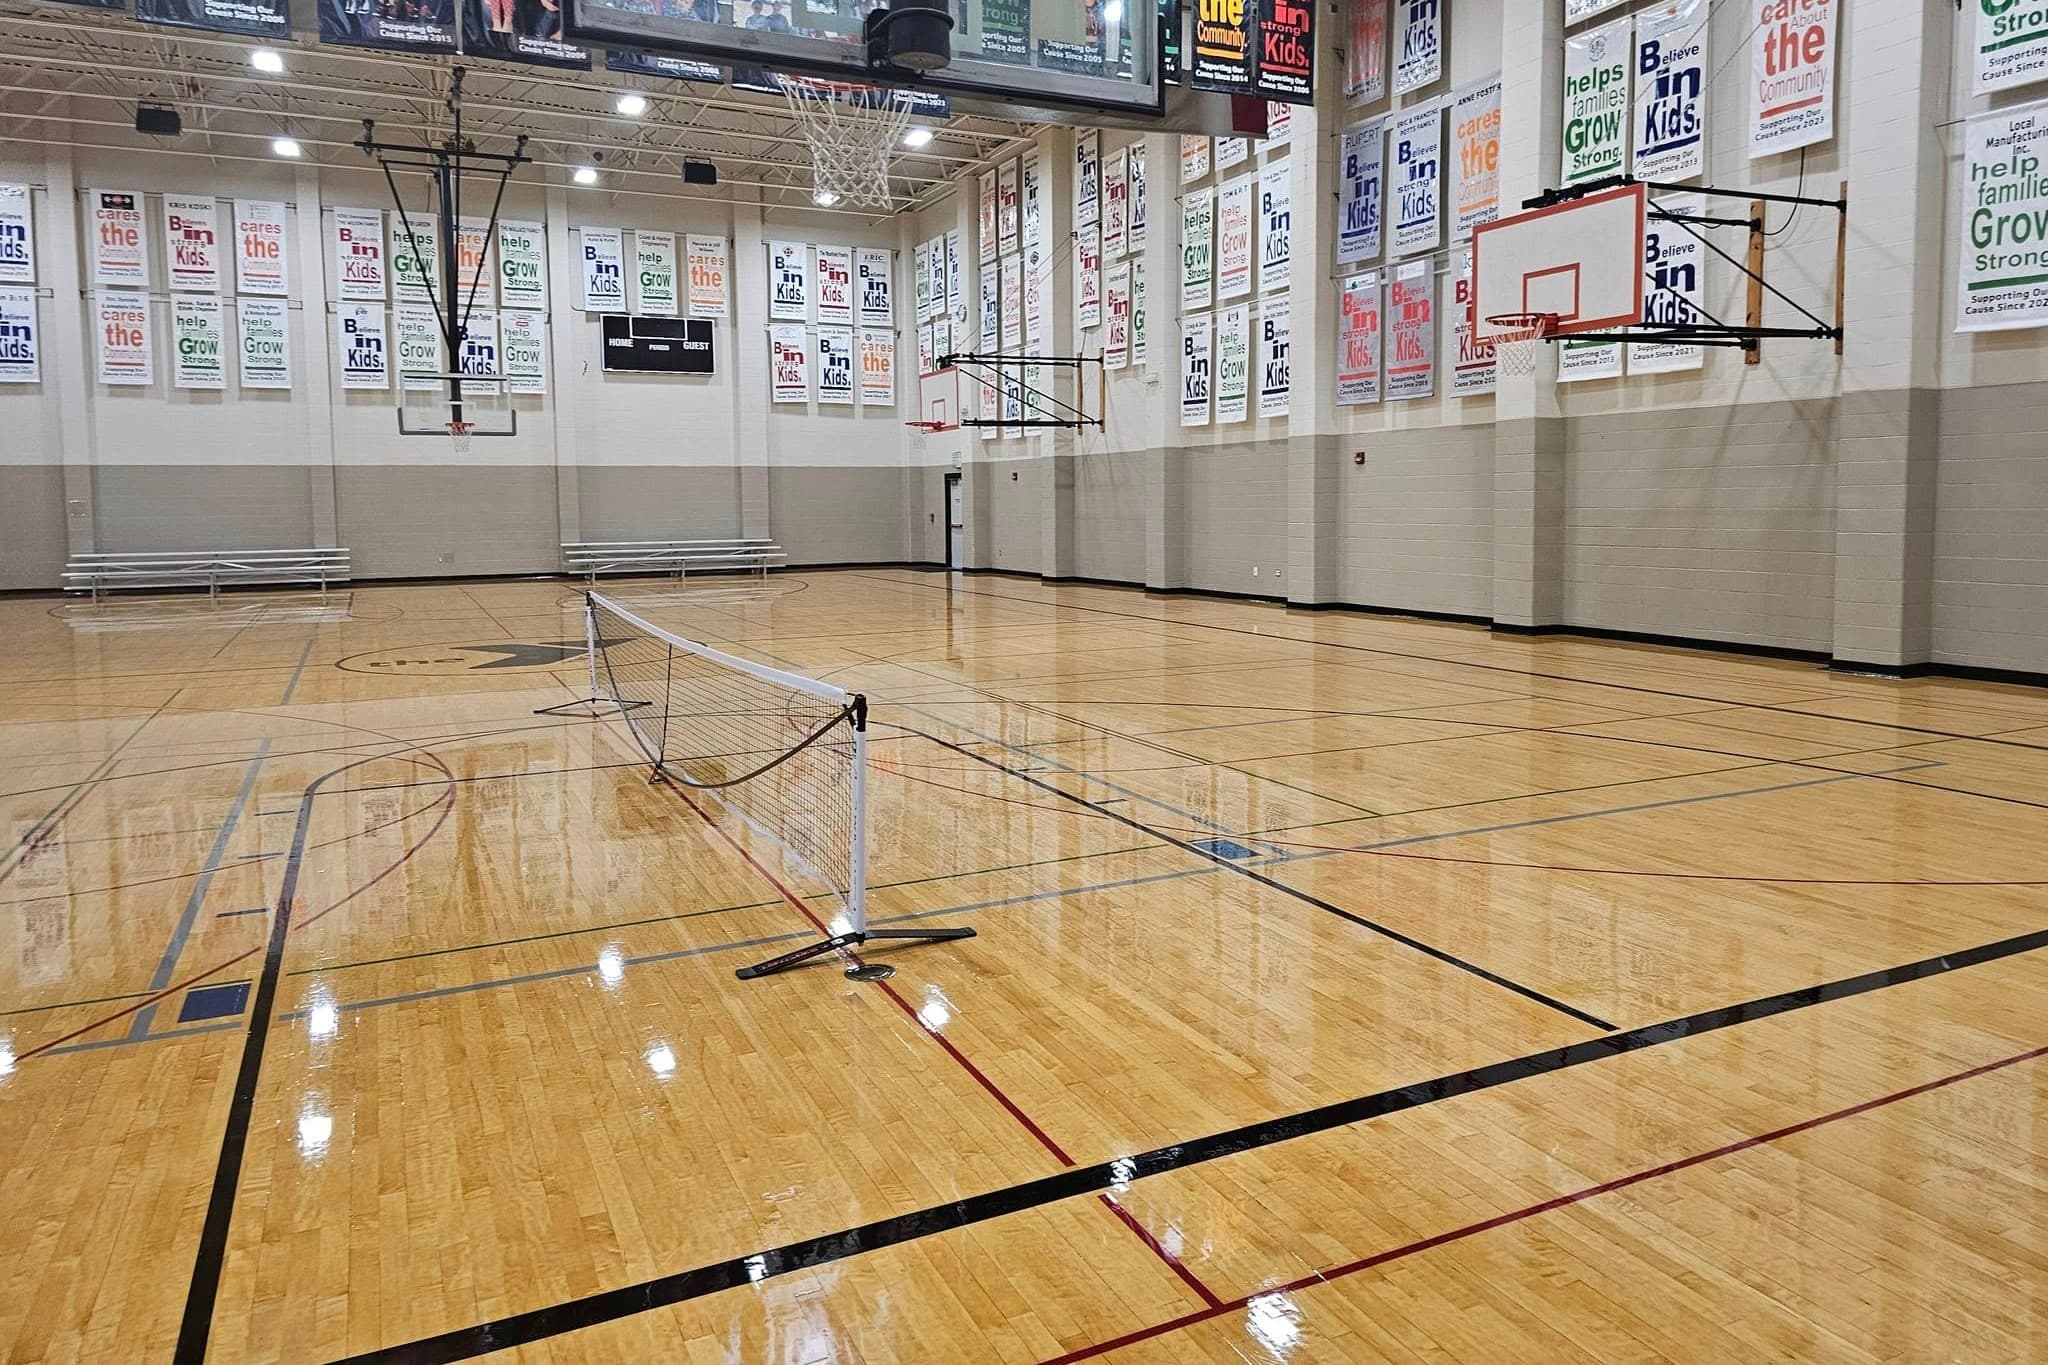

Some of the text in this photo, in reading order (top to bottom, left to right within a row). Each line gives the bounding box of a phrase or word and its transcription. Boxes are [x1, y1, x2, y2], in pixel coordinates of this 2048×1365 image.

[1275, 0, 1309, 32] in
[1791, 8, 1828, 29] About
[1261, 21, 1300, 36] strong
[1265, 32, 1309, 67] Kids.
[1404, 20, 1437, 60] Kids.
[1764, 23, 1825, 76] the
[1640, 40, 1700, 76] Believe
[1989, 46, 2048, 67] Supporting
[1982, 60, 2045, 80] Cause Since
[1567, 64, 1624, 97] helps
[1656, 67, 1701, 100] in
[1573, 87, 1625, 118] families
[1457, 108, 1502, 139] cares
[1645, 96, 1700, 145] Kids.
[1760, 109, 1822, 130] Supporting Our
[2009, 116, 2036, 131] Local
[1565, 109, 1621, 153] Grow
[1755, 131, 1778, 141] Cause
[1780, 125, 1801, 135] Since
[1398, 140, 1437, 165] Believes
[1461, 137, 1499, 180] the
[1573, 147, 1623, 169] Strong.
[1643, 150, 1694, 168] Supporting Our
[1347, 154, 1379, 179] Believe
[1409, 159, 1436, 181] in
[1638, 168, 1658, 179] Cause
[1660, 165, 1679, 175] Since
[1971, 154, 2039, 182] help
[1355, 176, 1378, 199] in
[1263, 192, 1289, 215] Believe
[1402, 189, 1435, 221] Kids.
[96, 209, 141, 222] cares
[1184, 211, 1210, 230] helps
[1271, 211, 1290, 232] in
[1347, 198, 1379, 230] Kids.
[101, 222, 139, 247] the
[184, 225, 214, 245] in
[240, 222, 281, 234] cares
[244, 234, 280, 259] the
[352, 242, 379, 259] in
[501, 235, 530, 250] help
[1222, 232, 1247, 255] Grow
[1646, 233, 1695, 263] Believe
[176, 246, 208, 266] Kids.
[638, 252, 662, 264] help
[689, 254, 725, 266] cares
[1184, 243, 1209, 270] Grow
[346, 261, 381, 279] Kids.
[503, 259, 538, 278] Grow
[596, 261, 619, 278] in
[691, 266, 722, 287] the
[783, 270, 802, 287] in
[1655, 261, 1696, 292] in
[590, 275, 621, 293] Kids.
[641, 271, 671, 288] Grow
[777, 283, 804, 301] Kids.
[822, 284, 844, 302] Kids.
[864, 291, 889, 308] Kids.
[1971, 291, 2029, 304] Supporting
[102, 311, 145, 322] cares
[1403, 297, 1430, 323] in
[1645, 290, 1697, 325] Kids.
[1965, 301, 2025, 315] Cause Since
[176, 315, 208, 329] help
[242, 317, 272, 328] help
[398, 322, 425, 333] help
[1353, 307, 1377, 331] in
[1393, 319, 1421, 331] strong
[106, 323, 144, 347] the
[355, 334, 382, 352] in
[505, 328, 531, 338] help
[1343, 329, 1369, 340] strong
[179, 338, 218, 355] Grow
[244, 337, 283, 354] Grow
[400, 341, 436, 358] Grow
[467, 341, 494, 360] in
[506, 346, 540, 362] Grow
[608, 338, 710, 350] HOME GUEST
[861, 341, 894, 353] cares
[1347, 339, 1373, 368] Kids.
[1396, 331, 1424, 362] Kids.
[1655, 349, 1674, 358] Since
[348, 348, 384, 368] Kids.
[829, 353, 850, 370] in
[863, 353, 890, 372] the
[1565, 350, 1599, 360] Supporting
[460, 356, 496, 376] Kids.
[778, 366, 801, 382] Kids.
[1191, 355, 1208, 376] in
[1220, 358, 1245, 380] Grow
[823, 368, 851, 386] Kids.
